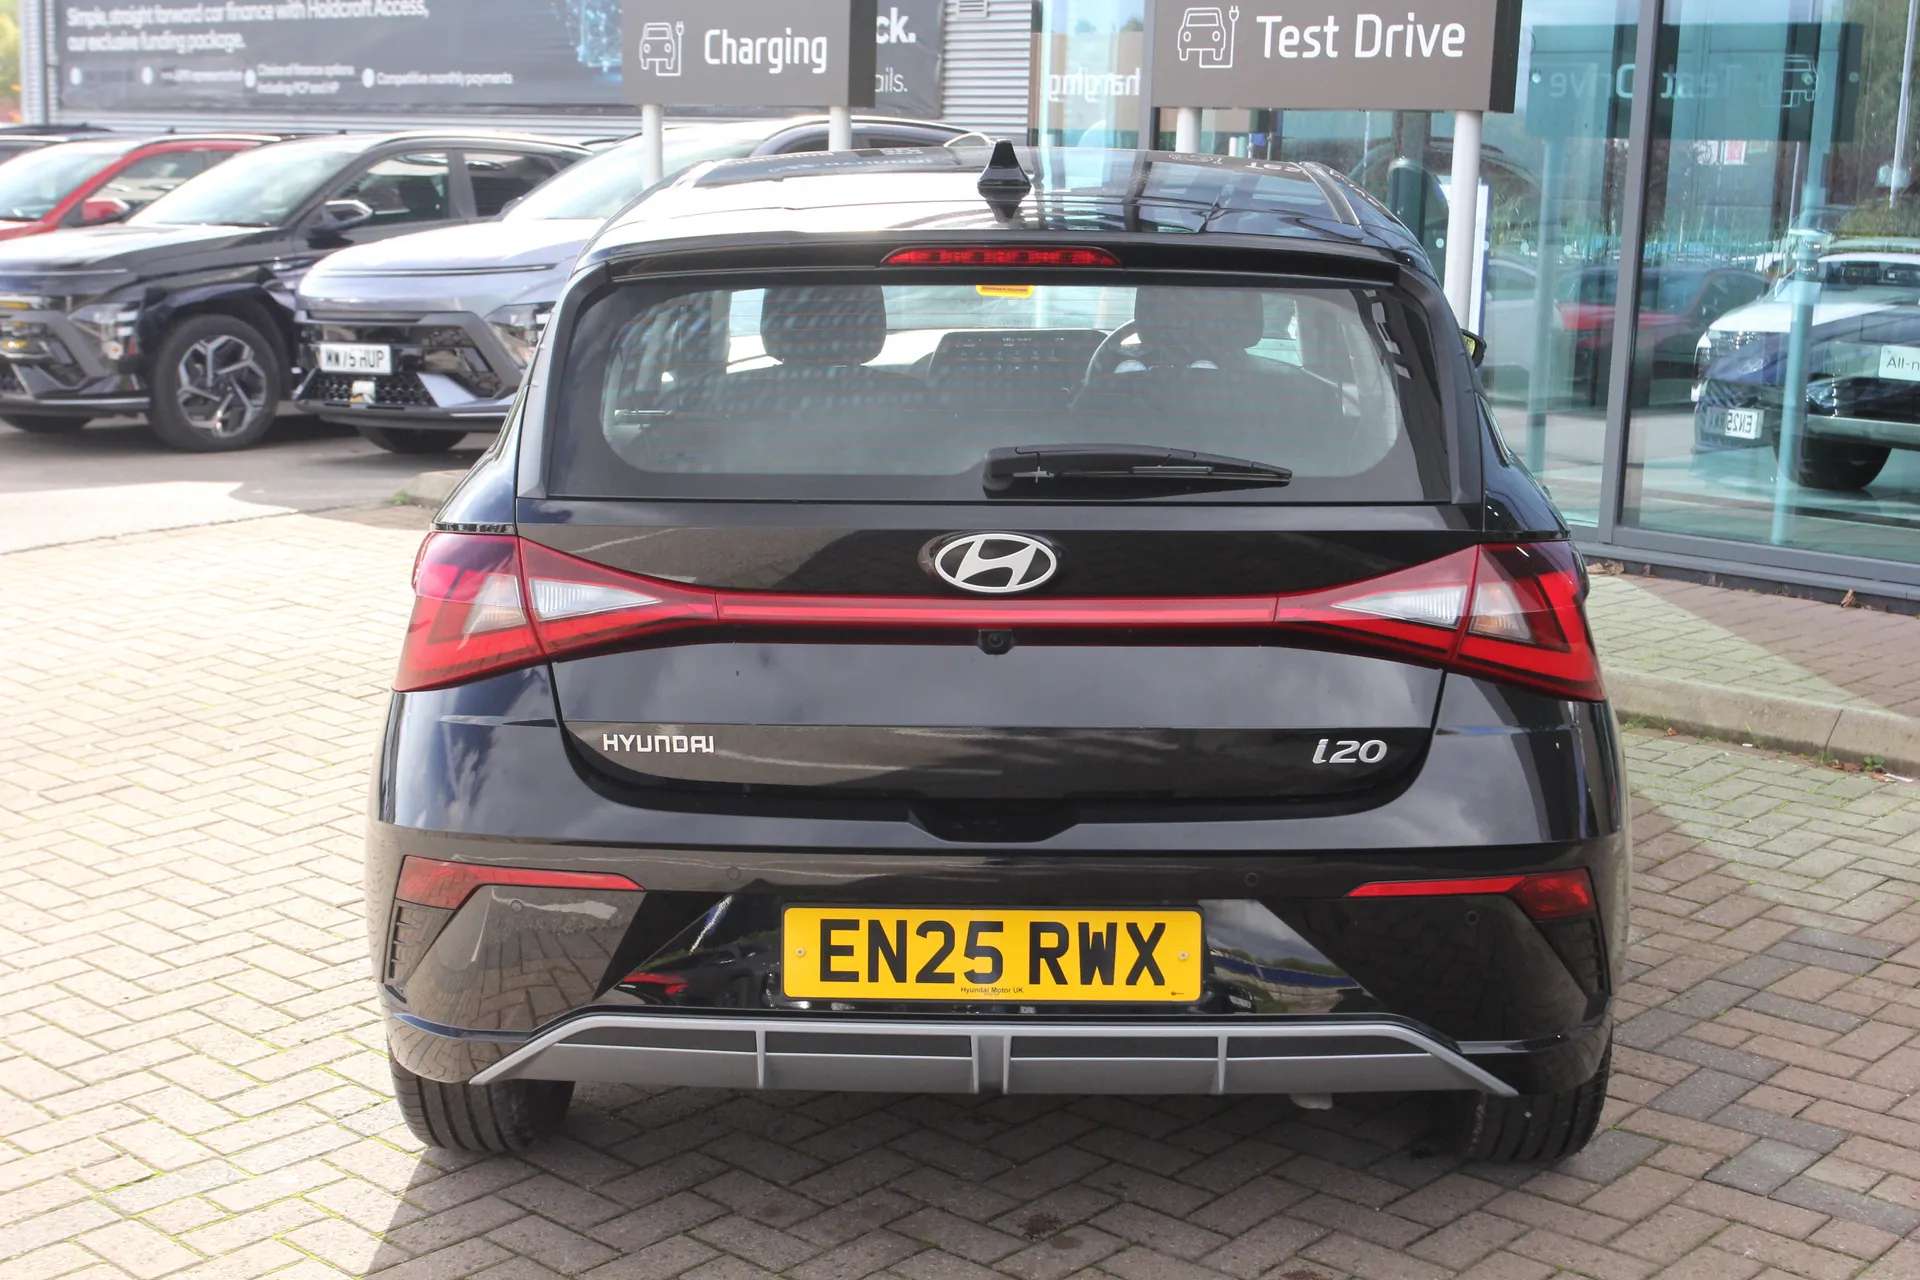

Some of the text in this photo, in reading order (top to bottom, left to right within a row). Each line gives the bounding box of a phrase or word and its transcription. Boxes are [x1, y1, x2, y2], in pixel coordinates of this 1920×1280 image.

[875, 7, 916, 44] ck.
[1256, 12, 1466, 58] Test Drive
[704, 27, 828, 74] Charging
[874, 67, 909, 92] ails.
[360, 350, 385, 368] HUP
[1886, 353, 1920, 371] All-n
[602, 733, 715, 753] HYUNDAI
[1312, 738, 1388, 764] i20
[819, 918, 1167, 986] EN25 RWX
